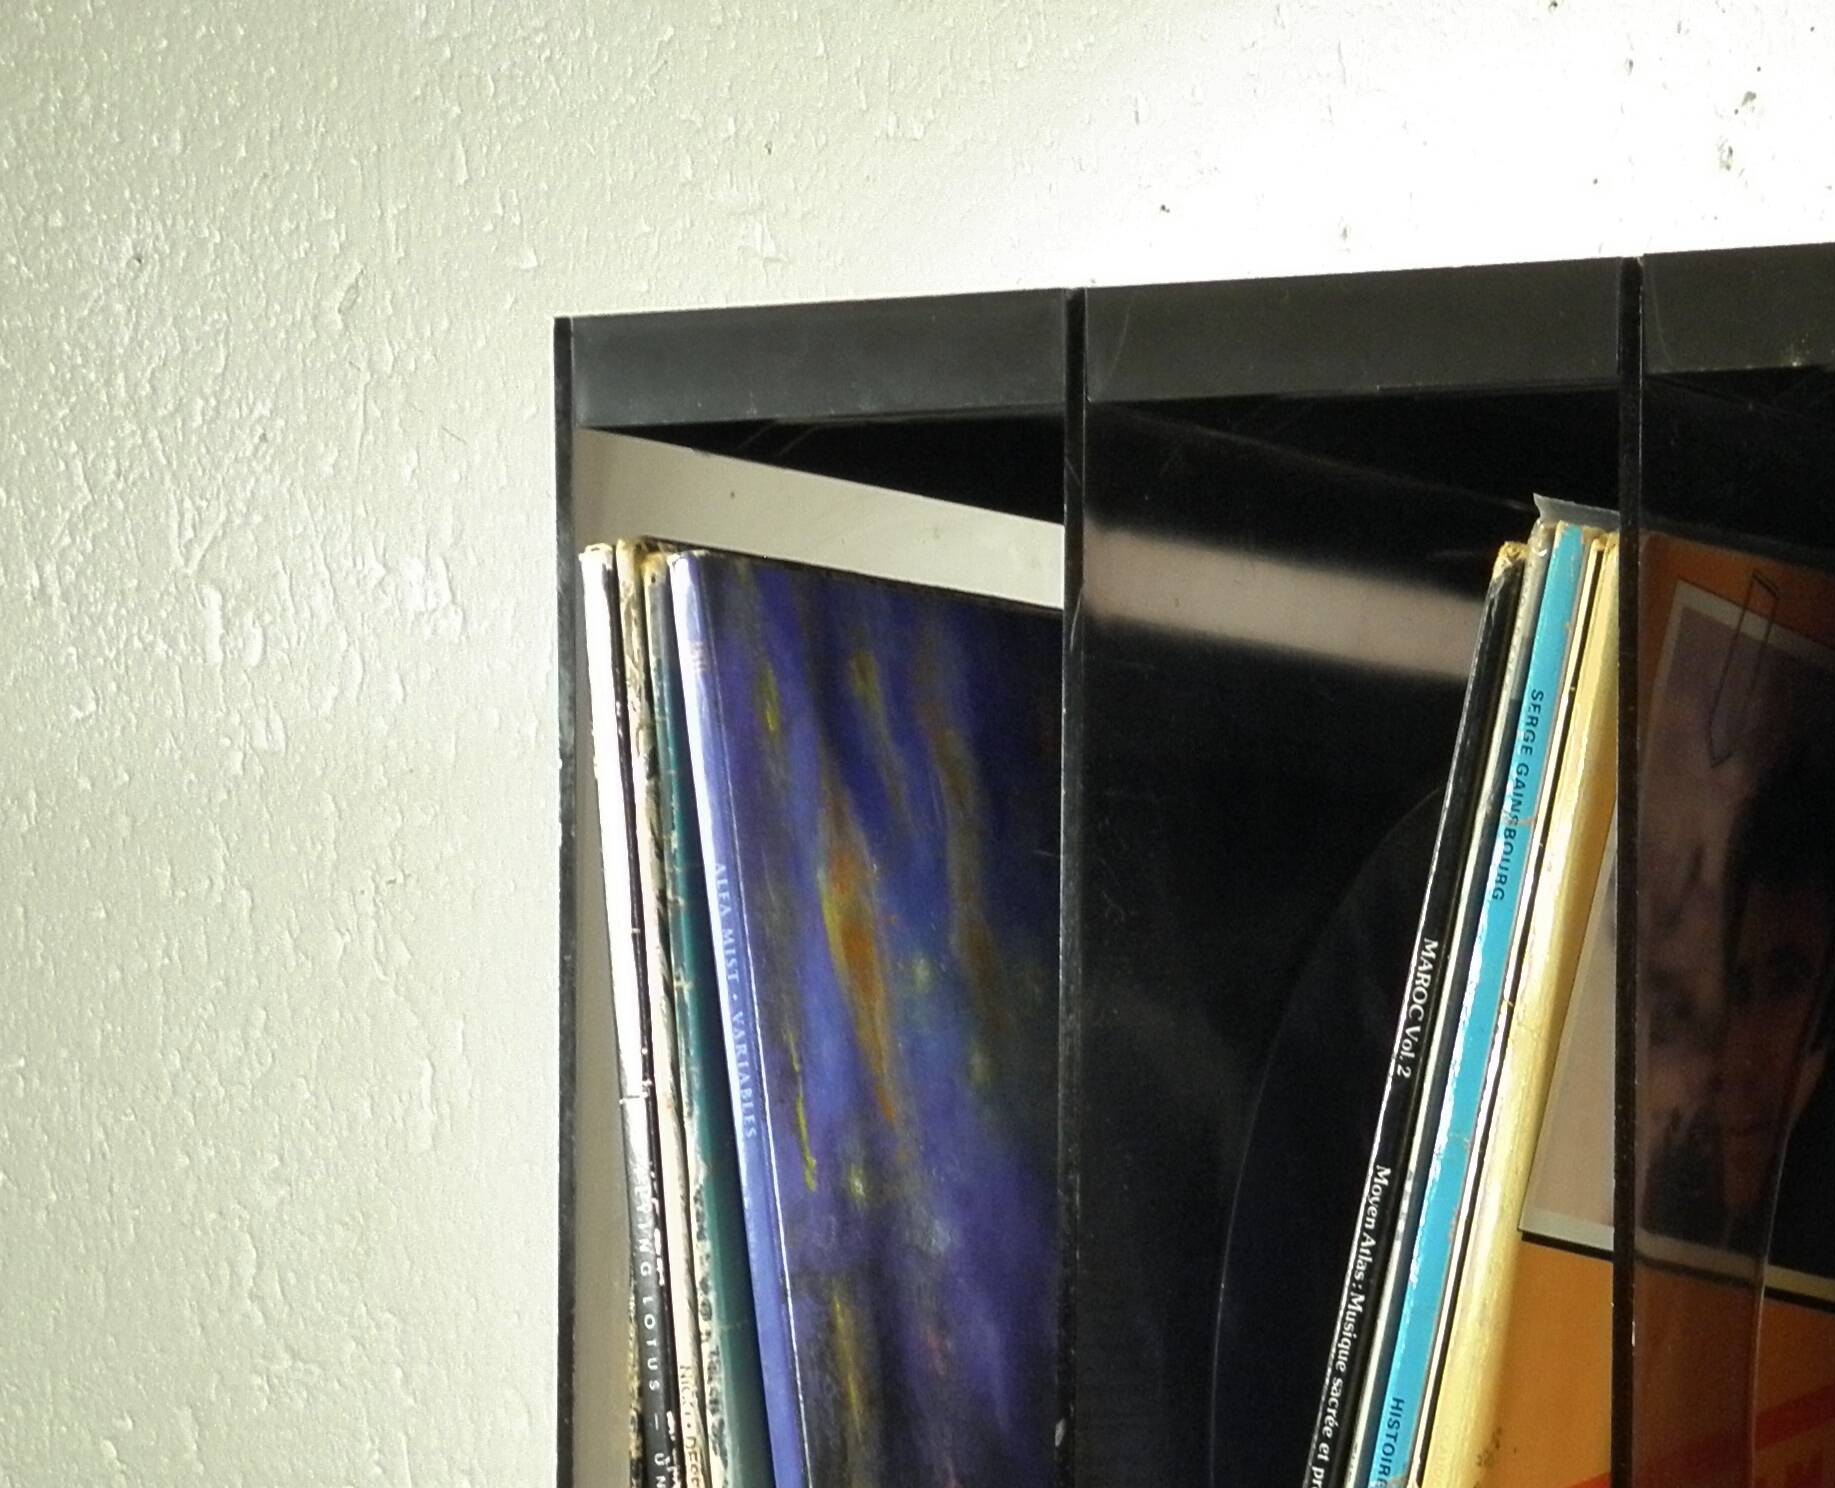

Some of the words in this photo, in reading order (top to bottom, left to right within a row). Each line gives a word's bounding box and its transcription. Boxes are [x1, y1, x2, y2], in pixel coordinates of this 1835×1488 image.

[1519, 687, 1545, 758] SERGE
[1492, 763, 1530, 901] GAINSBOURG
[713, 862, 732, 918] ALFA
[722, 928, 740, 984] MIST
[1408, 937, 1439, 1022] MAROC
[731, 1010, 757, 1139] VARIABLES
[1396, 1065, 1413, 1079] 2
[1399, 1025, 1422, 1060] Vol.
[1364, 1164, 1392, 1231] Moyen
[641, 1294, 661, 1391] LOTUS
[1335, 1293, 1366, 1372] Musique
[1319, 1373, 1344, 1441] sacrée
[1316, 1442, 1331, 1461] et
[1376, 1397, 1406, 1488] HISTOIRE
